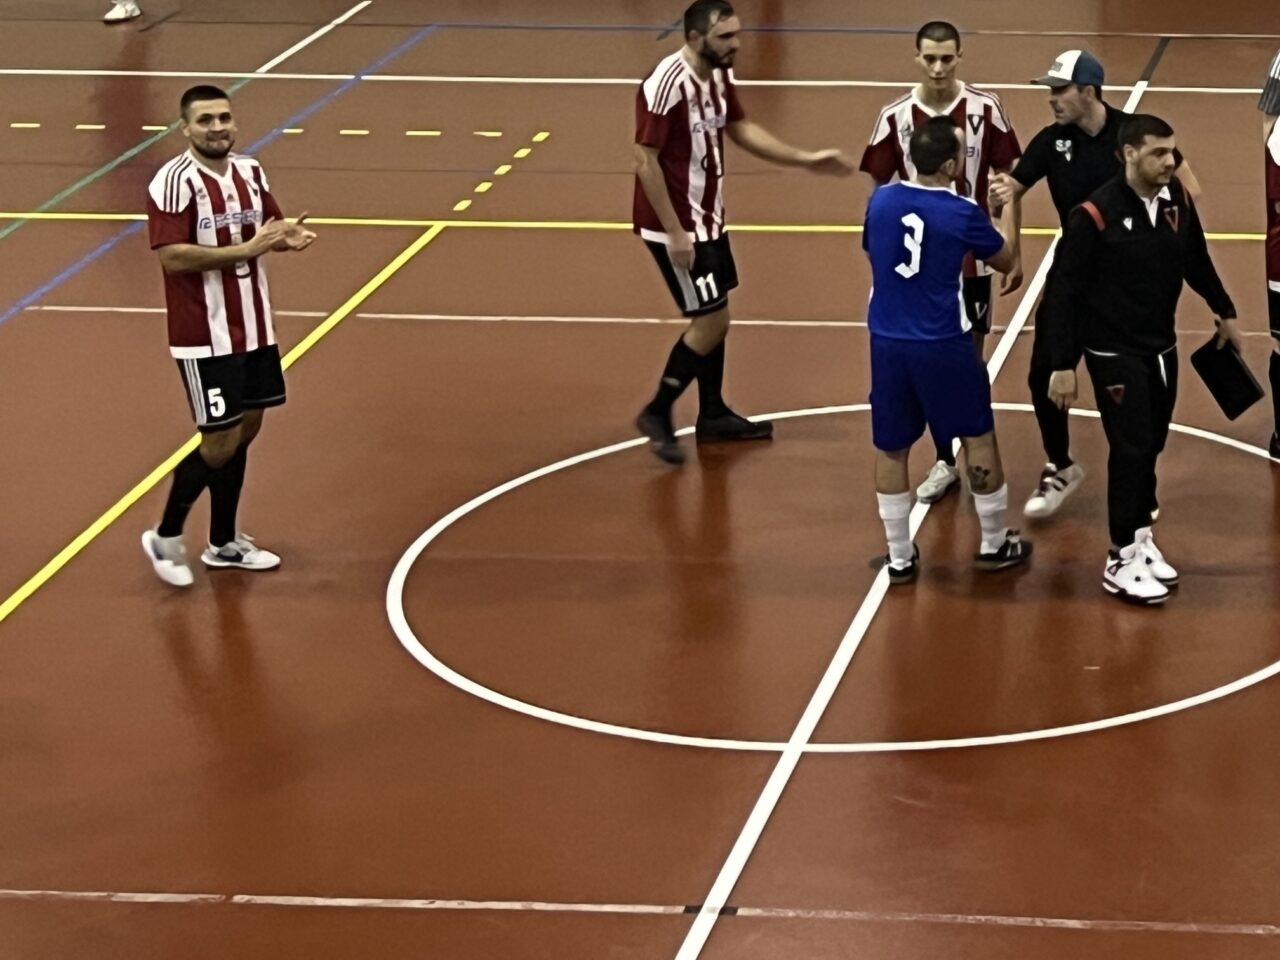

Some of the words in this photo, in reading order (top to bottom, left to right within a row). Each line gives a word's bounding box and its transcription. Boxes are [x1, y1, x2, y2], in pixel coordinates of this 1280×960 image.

[894, 212, 925, 279] 3
[695, 272, 718, 302] 11
[207, 387, 226, 418] 5
